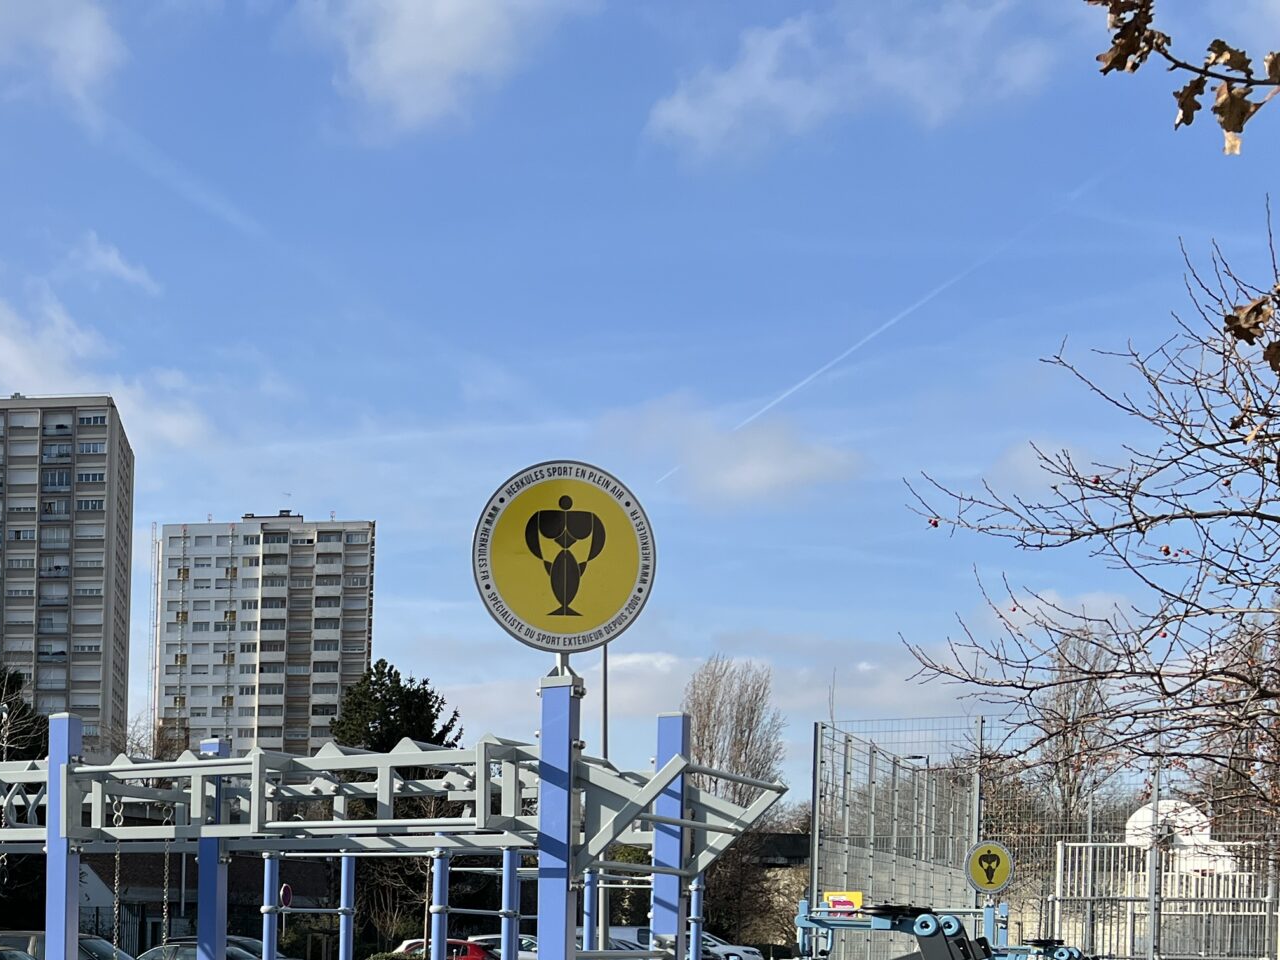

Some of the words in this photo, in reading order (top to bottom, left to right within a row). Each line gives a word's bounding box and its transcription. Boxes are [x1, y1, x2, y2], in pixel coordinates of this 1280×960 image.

[507, 470, 545, 497] HERKULES
[546, 466, 573, 478] SPORT
[576, 468, 587, 478] EN
[588, 471, 611, 489] PLEIN
[610, 486, 624, 500] AIR
[478, 505, 500, 581] WWW.HERKULES.FR
[630, 509, 651, 584] WWW.HERKULES.FR
[487, 592, 524, 633] SPÉCIALISTE
[524, 628, 536, 639] DU
[536, 633, 560, 646] SPORT
[562, 631, 604, 647] EXTÉRIEUR
[603, 614, 628, 635] DEPUIS
[624, 594, 641, 615] 2006
